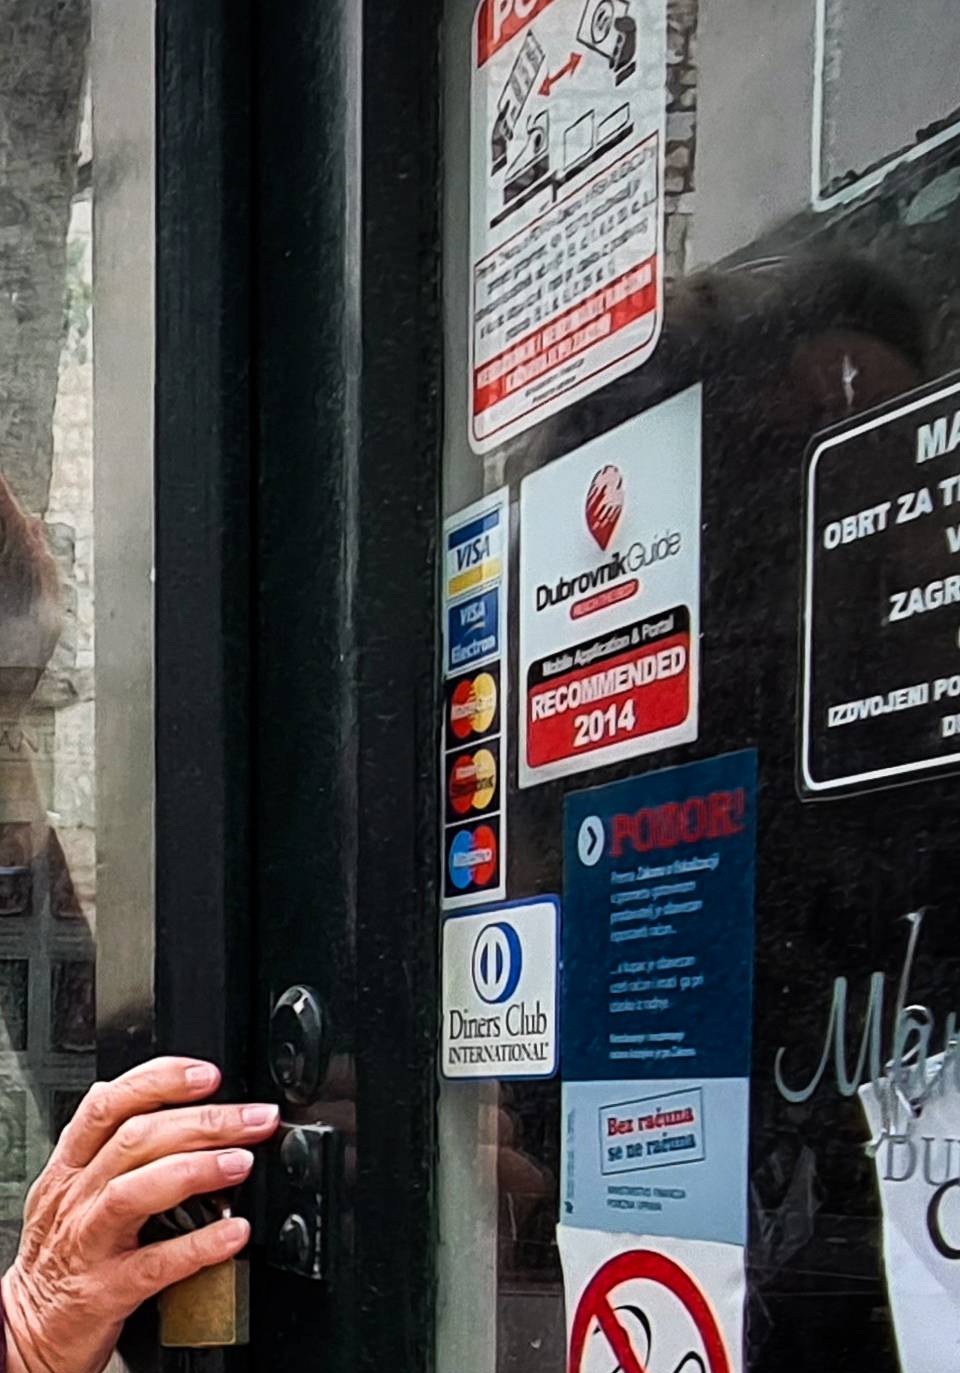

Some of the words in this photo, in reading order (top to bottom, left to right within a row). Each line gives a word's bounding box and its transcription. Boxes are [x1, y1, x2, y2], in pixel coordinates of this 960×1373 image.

[822, 502, 891, 550] OBRT
[895, 487, 933, 524] ZA
[456, 536, 490, 572] VISA
[459, 601, 486, 626] VISA
[451, 635, 496, 665] Electron
[531, 645, 686, 722] RECOMMENDED
[572, 699, 636, 748] 2014
[828, 682, 930, 728] IZDVOJENI
[449, 1009, 501, 1040] Diners
[505, 1000, 548, 1037] Club
[606, 1117, 635, 1137] Bez
[607, 1146, 624, 1162] se
[626, 1143, 643, 1159] ne
